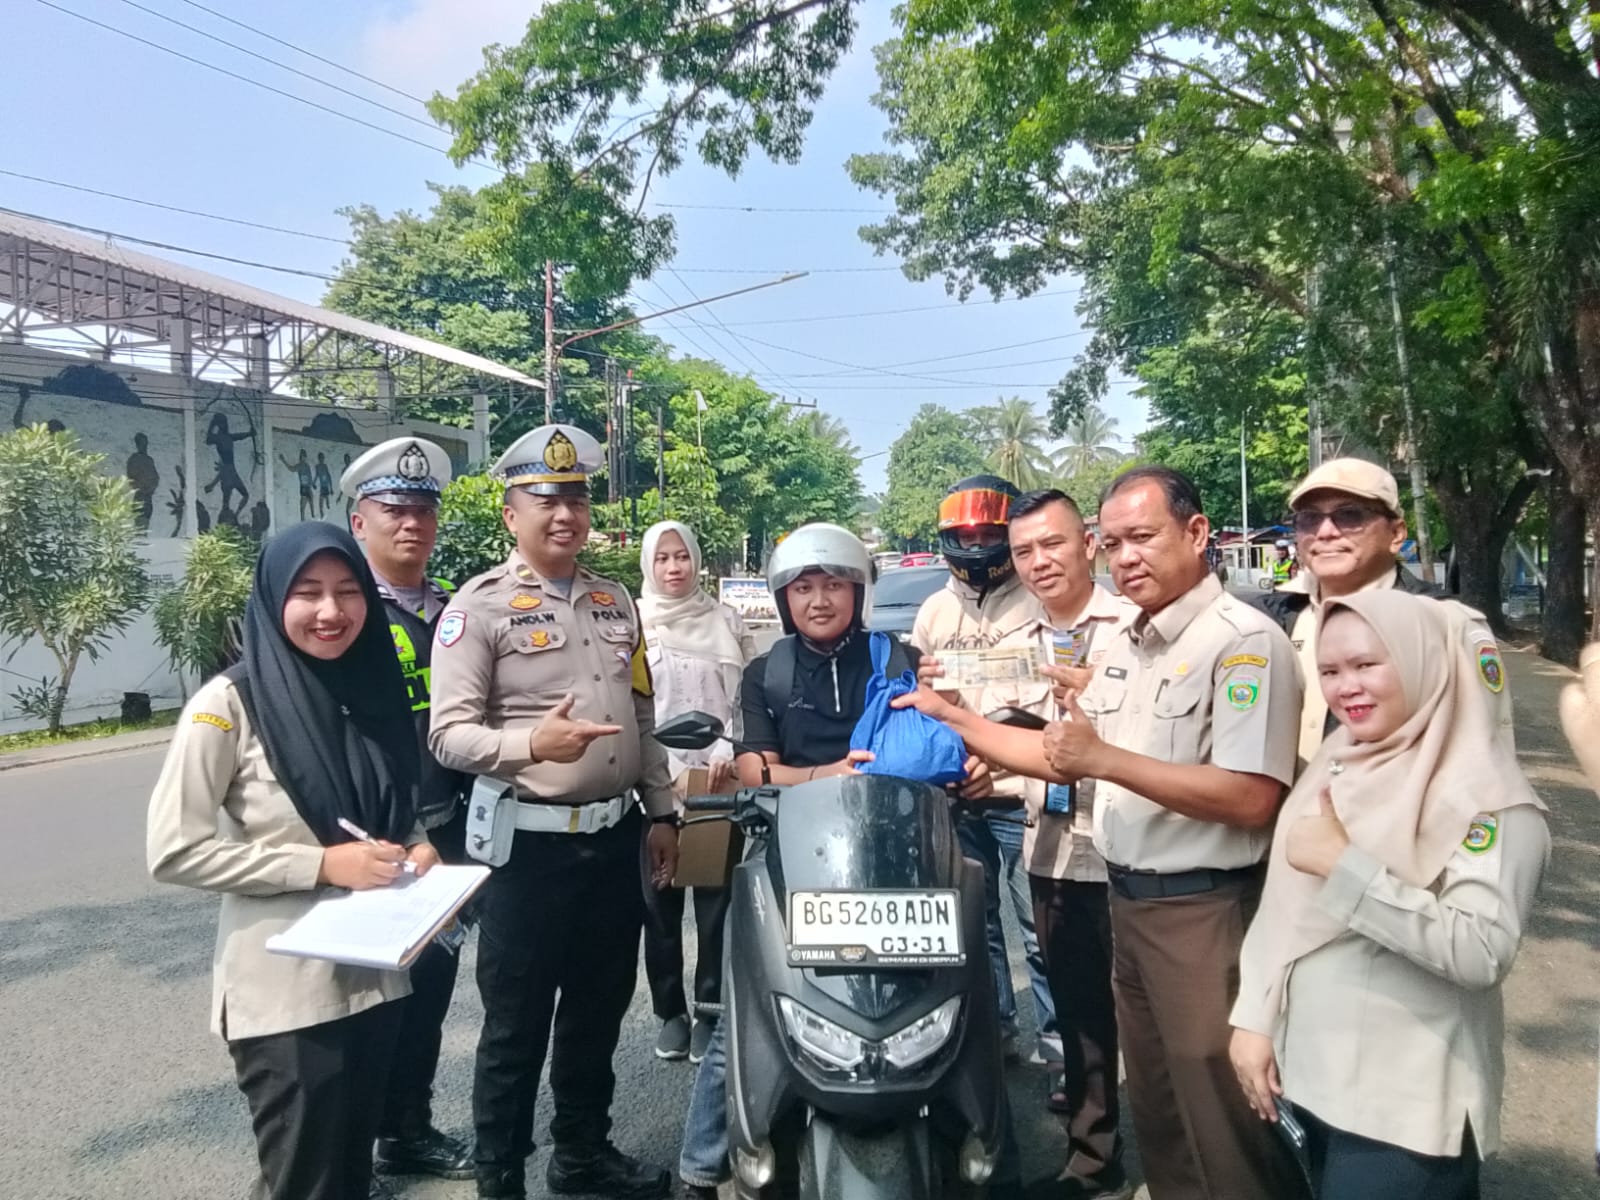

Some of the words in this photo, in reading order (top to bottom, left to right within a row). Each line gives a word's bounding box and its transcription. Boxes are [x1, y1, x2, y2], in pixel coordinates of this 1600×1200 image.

[804, 901, 833, 925] BG
[838, 901, 899, 925] 5268
[905, 900, 949, 925] ADN
[801, 950, 836, 961] YAMAHA
